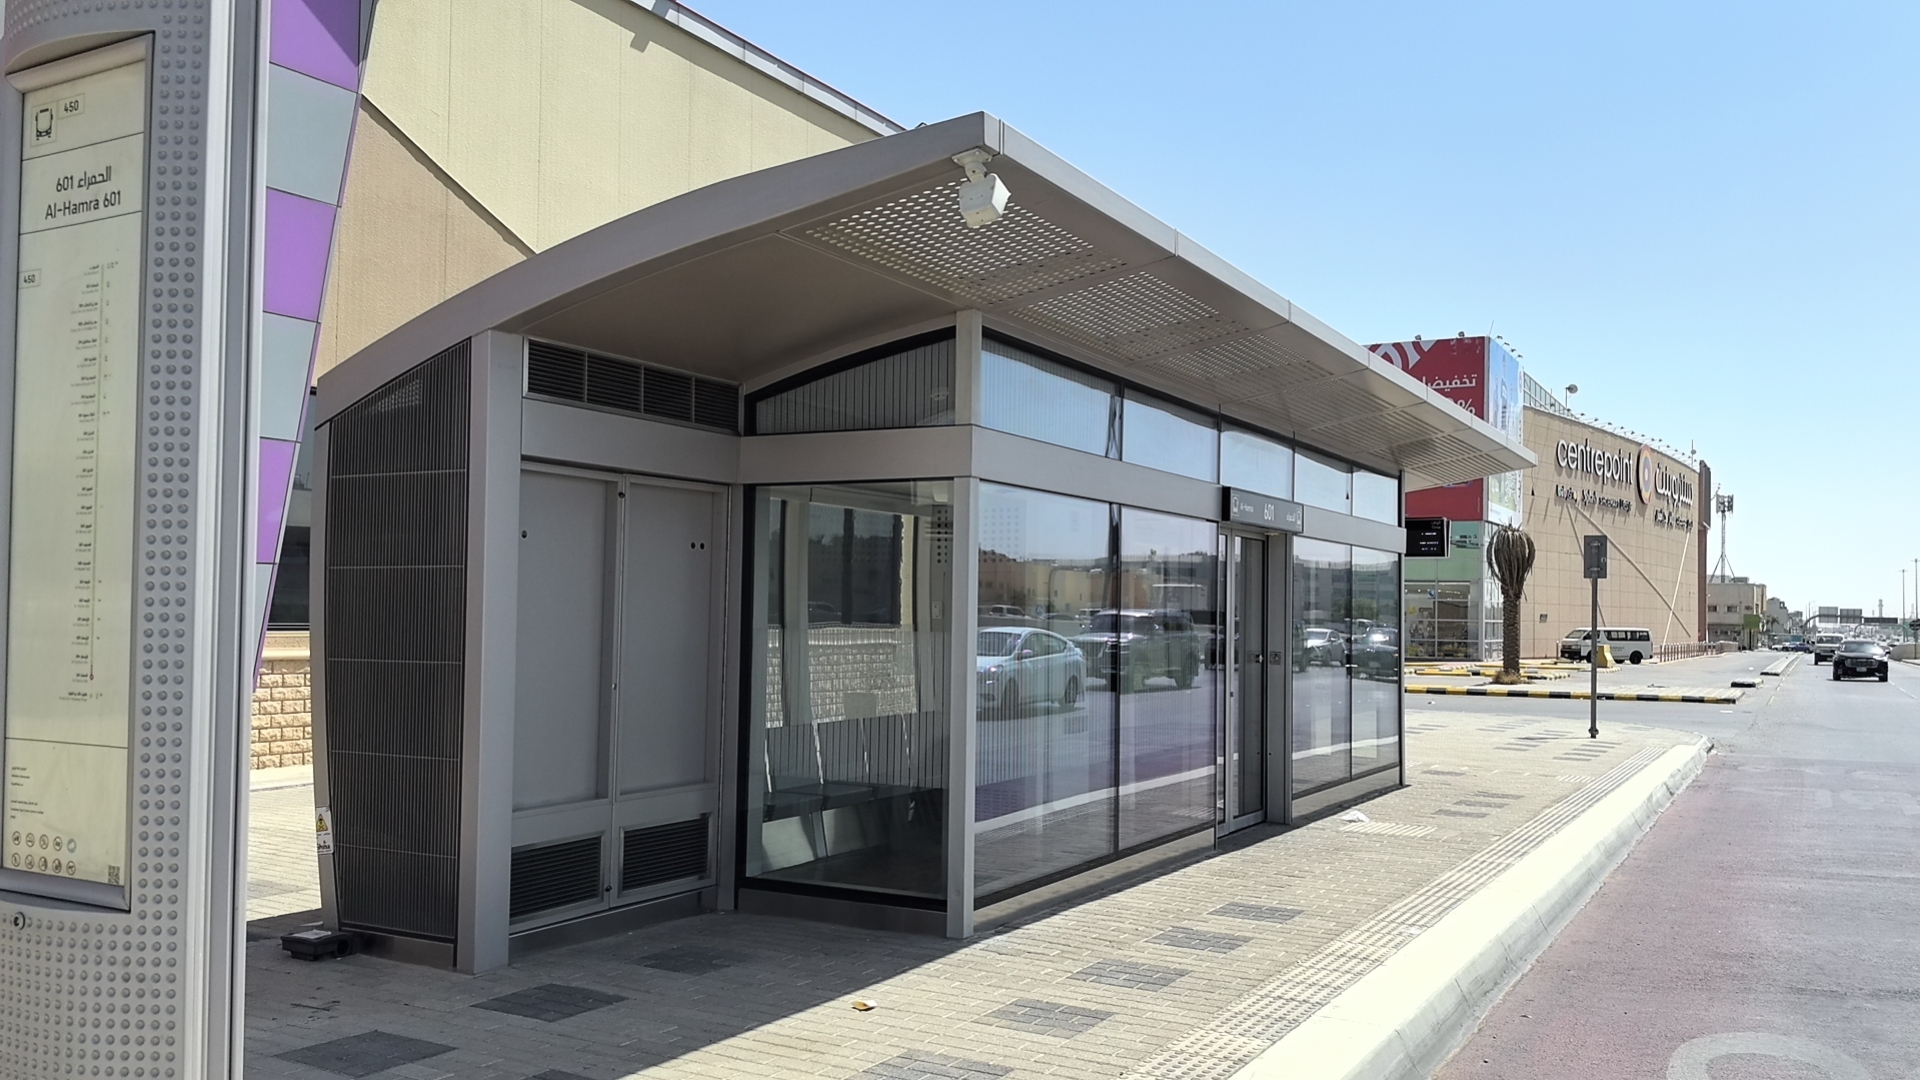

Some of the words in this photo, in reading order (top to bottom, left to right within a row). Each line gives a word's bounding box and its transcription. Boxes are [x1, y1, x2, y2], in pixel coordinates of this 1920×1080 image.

[63, 99, 79, 113] 450
[55, 175, 74, 193] 601
[77, 166, 112, 190] الحمراء
[44, 198, 100, 220] Al-Hamra
[103, 190, 121, 208] 601
[23, 274, 36, 285] 450
[1557, 438, 1634, 485] centrepoint
[1264, 503, 1275, 521] 601
